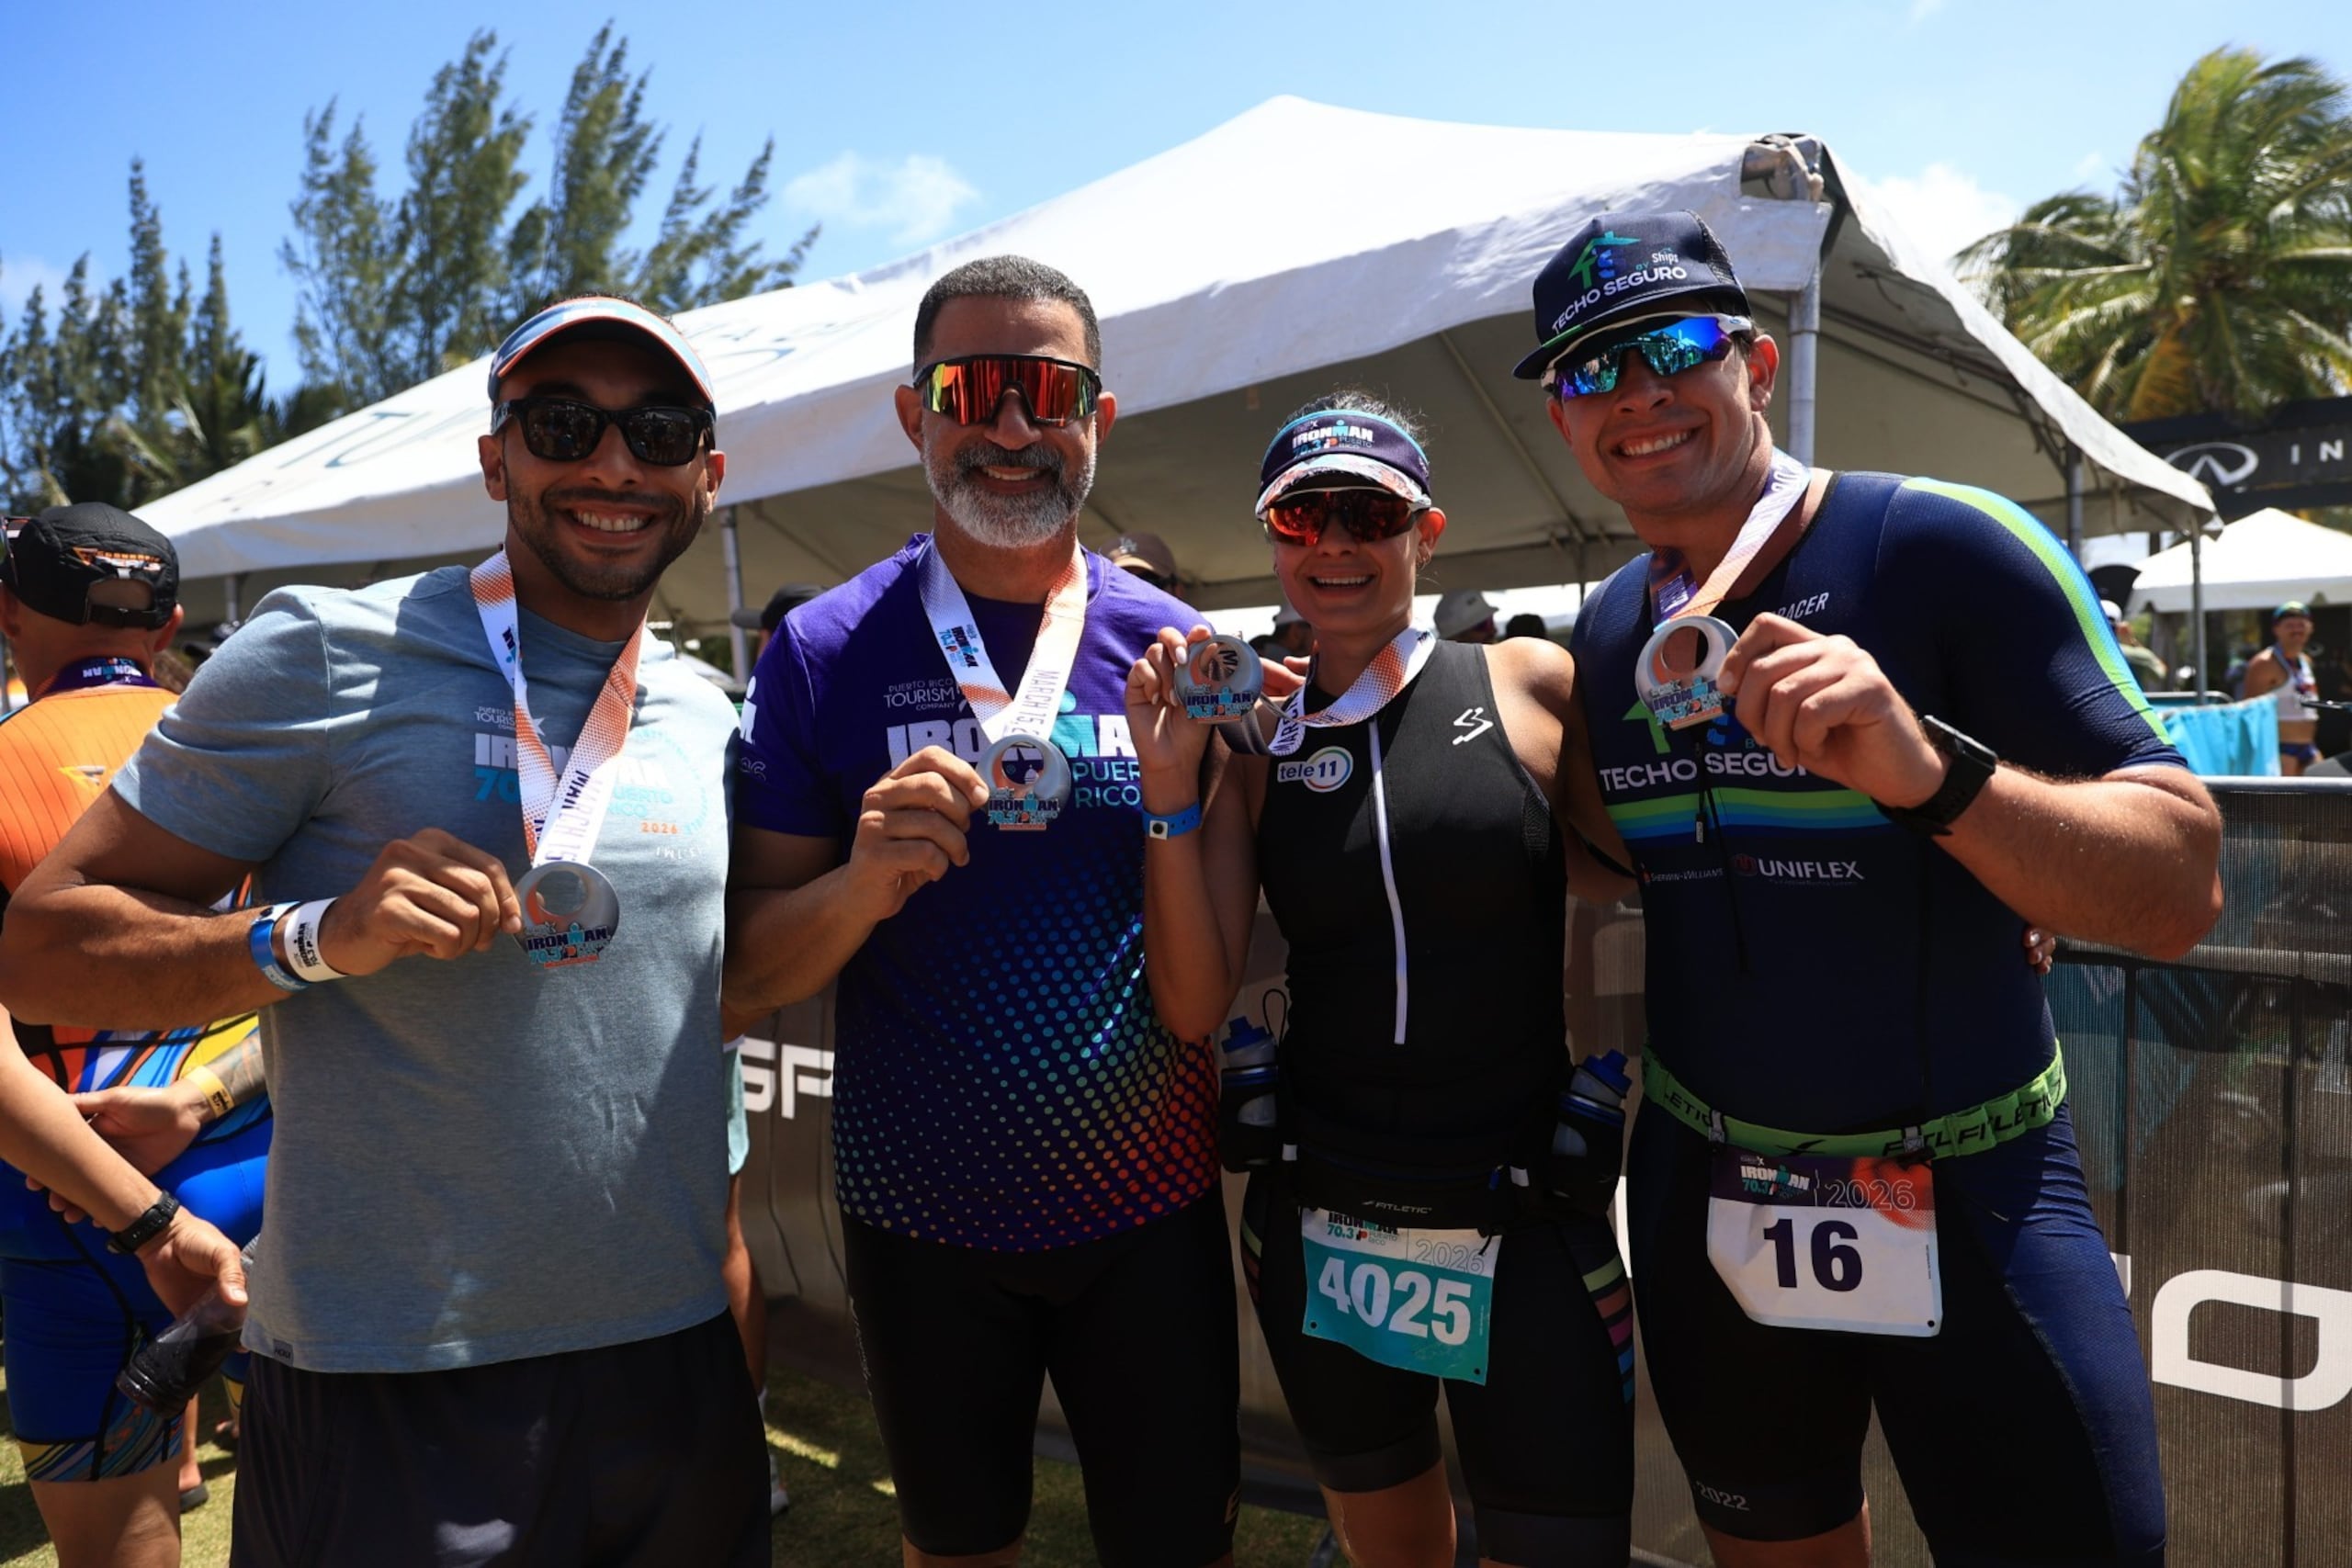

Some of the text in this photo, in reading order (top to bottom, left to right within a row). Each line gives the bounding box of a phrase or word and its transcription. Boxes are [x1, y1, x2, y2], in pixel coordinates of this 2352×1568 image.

[1651, 253, 1679, 265] Ships
[1552, 265, 1688, 334] TECHO SEGURO
[1292, 420, 1375, 450] IRONMAN
[1773, 592, 1830, 620] RACER
[951, 626, 978, 669] IRONMAN
[889, 678, 954, 694] PUERTO RICO
[1023, 670, 1061, 709] MARCH
[1187, 687, 1251, 706] IRONMAN
[883, 687, 956, 709] TOURISM
[915, 702, 956, 712] COMPANY
[474, 711, 516, 727] TOURIS
[479, 705, 506, 716] PUERTO
[1655, 705, 1687, 726] 70.3
[1073, 761, 1141, 783] PUER
[1600, 752, 1807, 792] TECHO SEGU
[613, 785, 673, 805] UERTO
[989, 793, 1059, 811] IRONMAN
[1074, 786, 1141, 808] RICO
[610, 802, 649, 818] ICO
[989, 810, 1016, 825] 70.3
[641, 821, 679, 834] 2026
[1758, 857, 1865, 880] UNIFLEX
[526, 923, 608, 951] IRONMAN
[528, 947, 562, 964] 70.3
[1740, 1165, 1810, 1191] IRONMAN
[1824, 1179, 1917, 1212] 2026
[1375, 1201, 1430, 1214] FITLETIC
[1327, 1223, 1354, 1239] 70.3
[1416, 1238, 1486, 1275] 2026
[1763, 1217, 1863, 1292] 16
[1318, 1256, 1472, 1346] 4025
[1696, 1481, 1750, 1511] 2022
